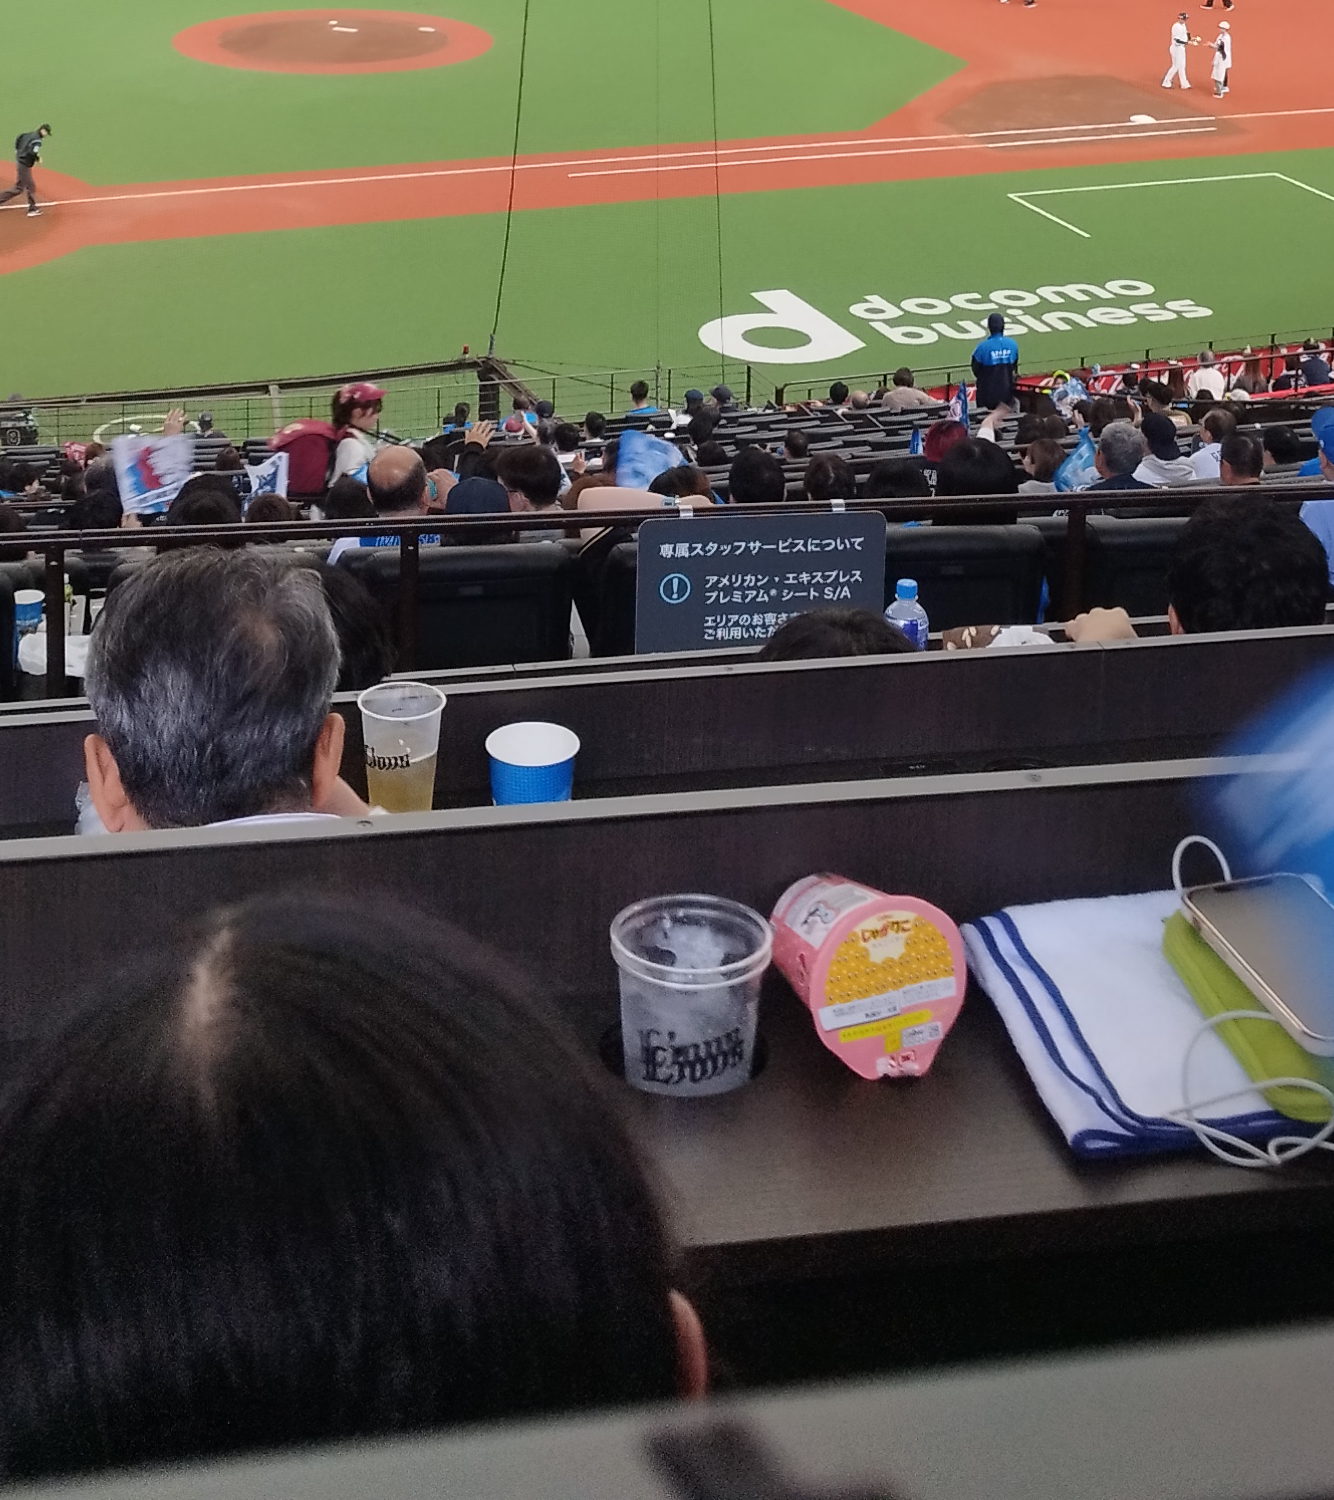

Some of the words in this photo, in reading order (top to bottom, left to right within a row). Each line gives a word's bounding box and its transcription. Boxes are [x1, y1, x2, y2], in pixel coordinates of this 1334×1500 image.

[848, 278, 1156, 320] docomo
[868, 298, 1214, 346] business
[659, 537, 865, 558] 専属スタッフサービスについて
